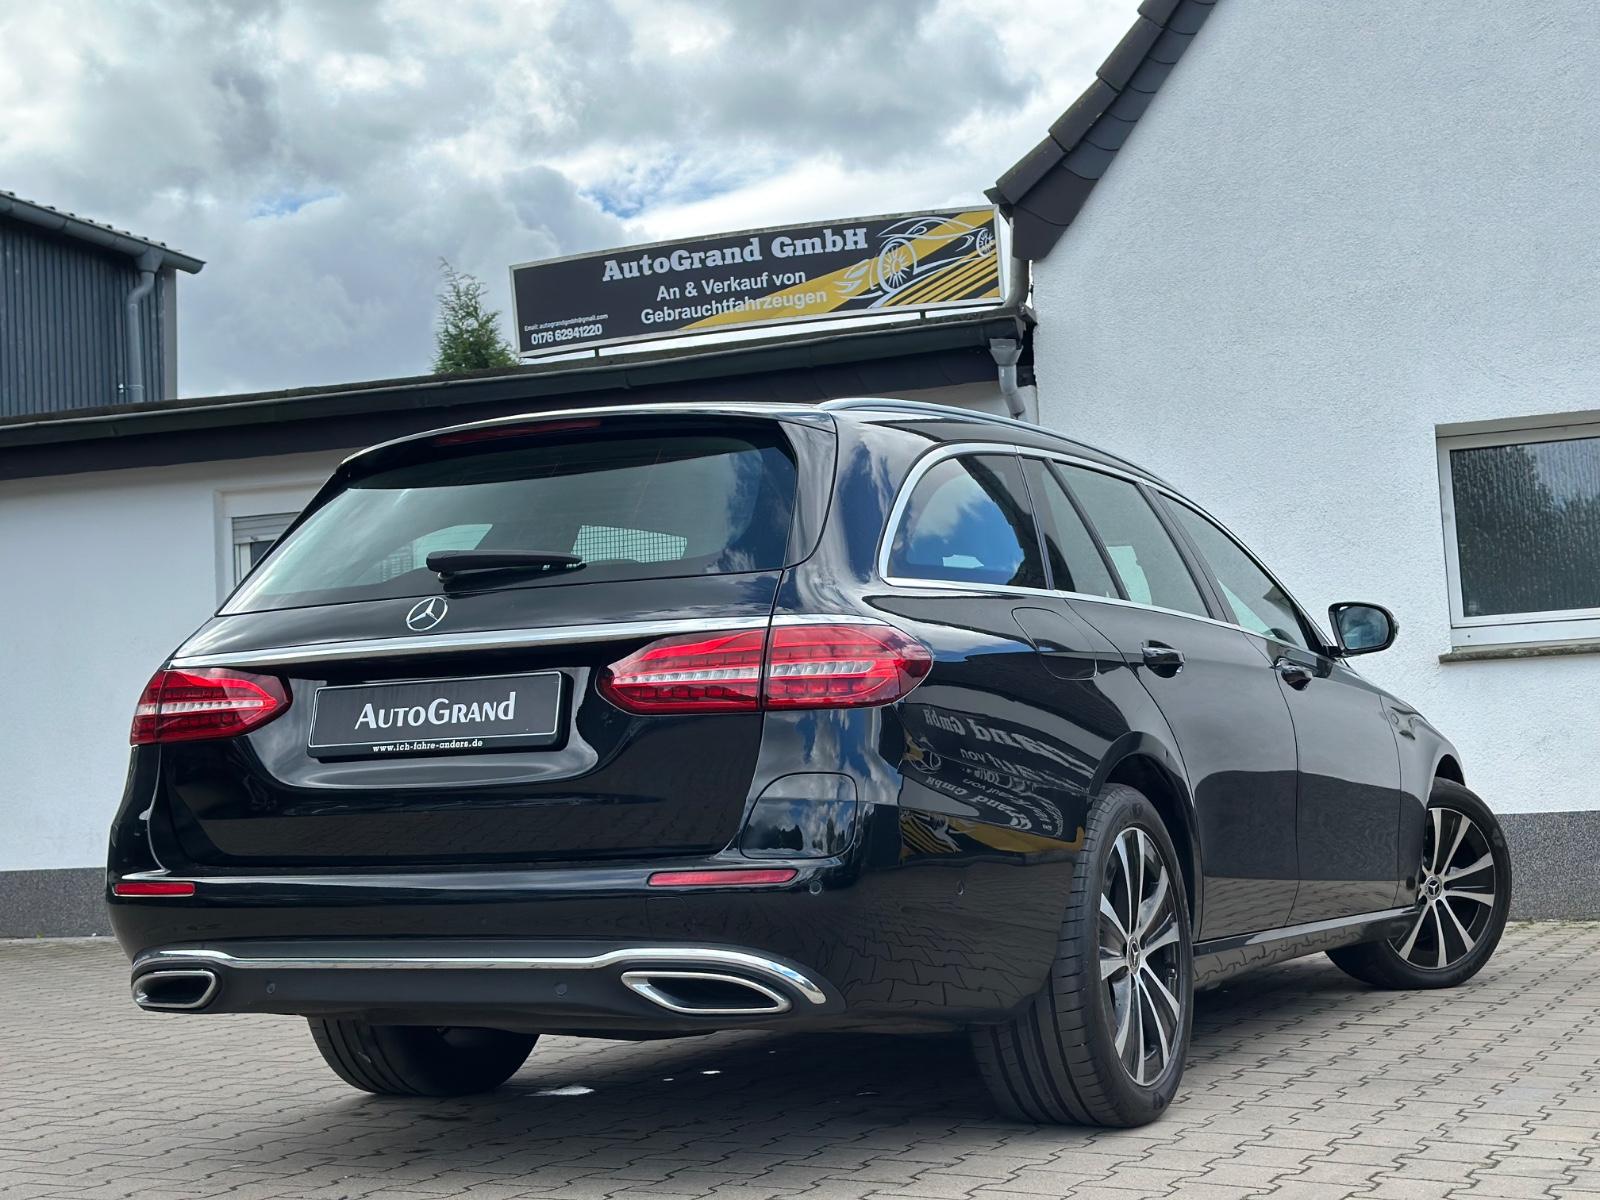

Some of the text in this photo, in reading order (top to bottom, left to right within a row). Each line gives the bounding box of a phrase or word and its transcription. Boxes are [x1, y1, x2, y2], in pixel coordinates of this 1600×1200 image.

[602, 227, 868, 281] AutoGrand GmbH
[656, 271, 806, 301] An & Verkauf von
[640, 290, 827, 325] Gebrauchtfahrzeugen
[531, 324, 603, 345] 0176 62941220
[372, 739, 483, 754] www.ich-fahre-anders.de
